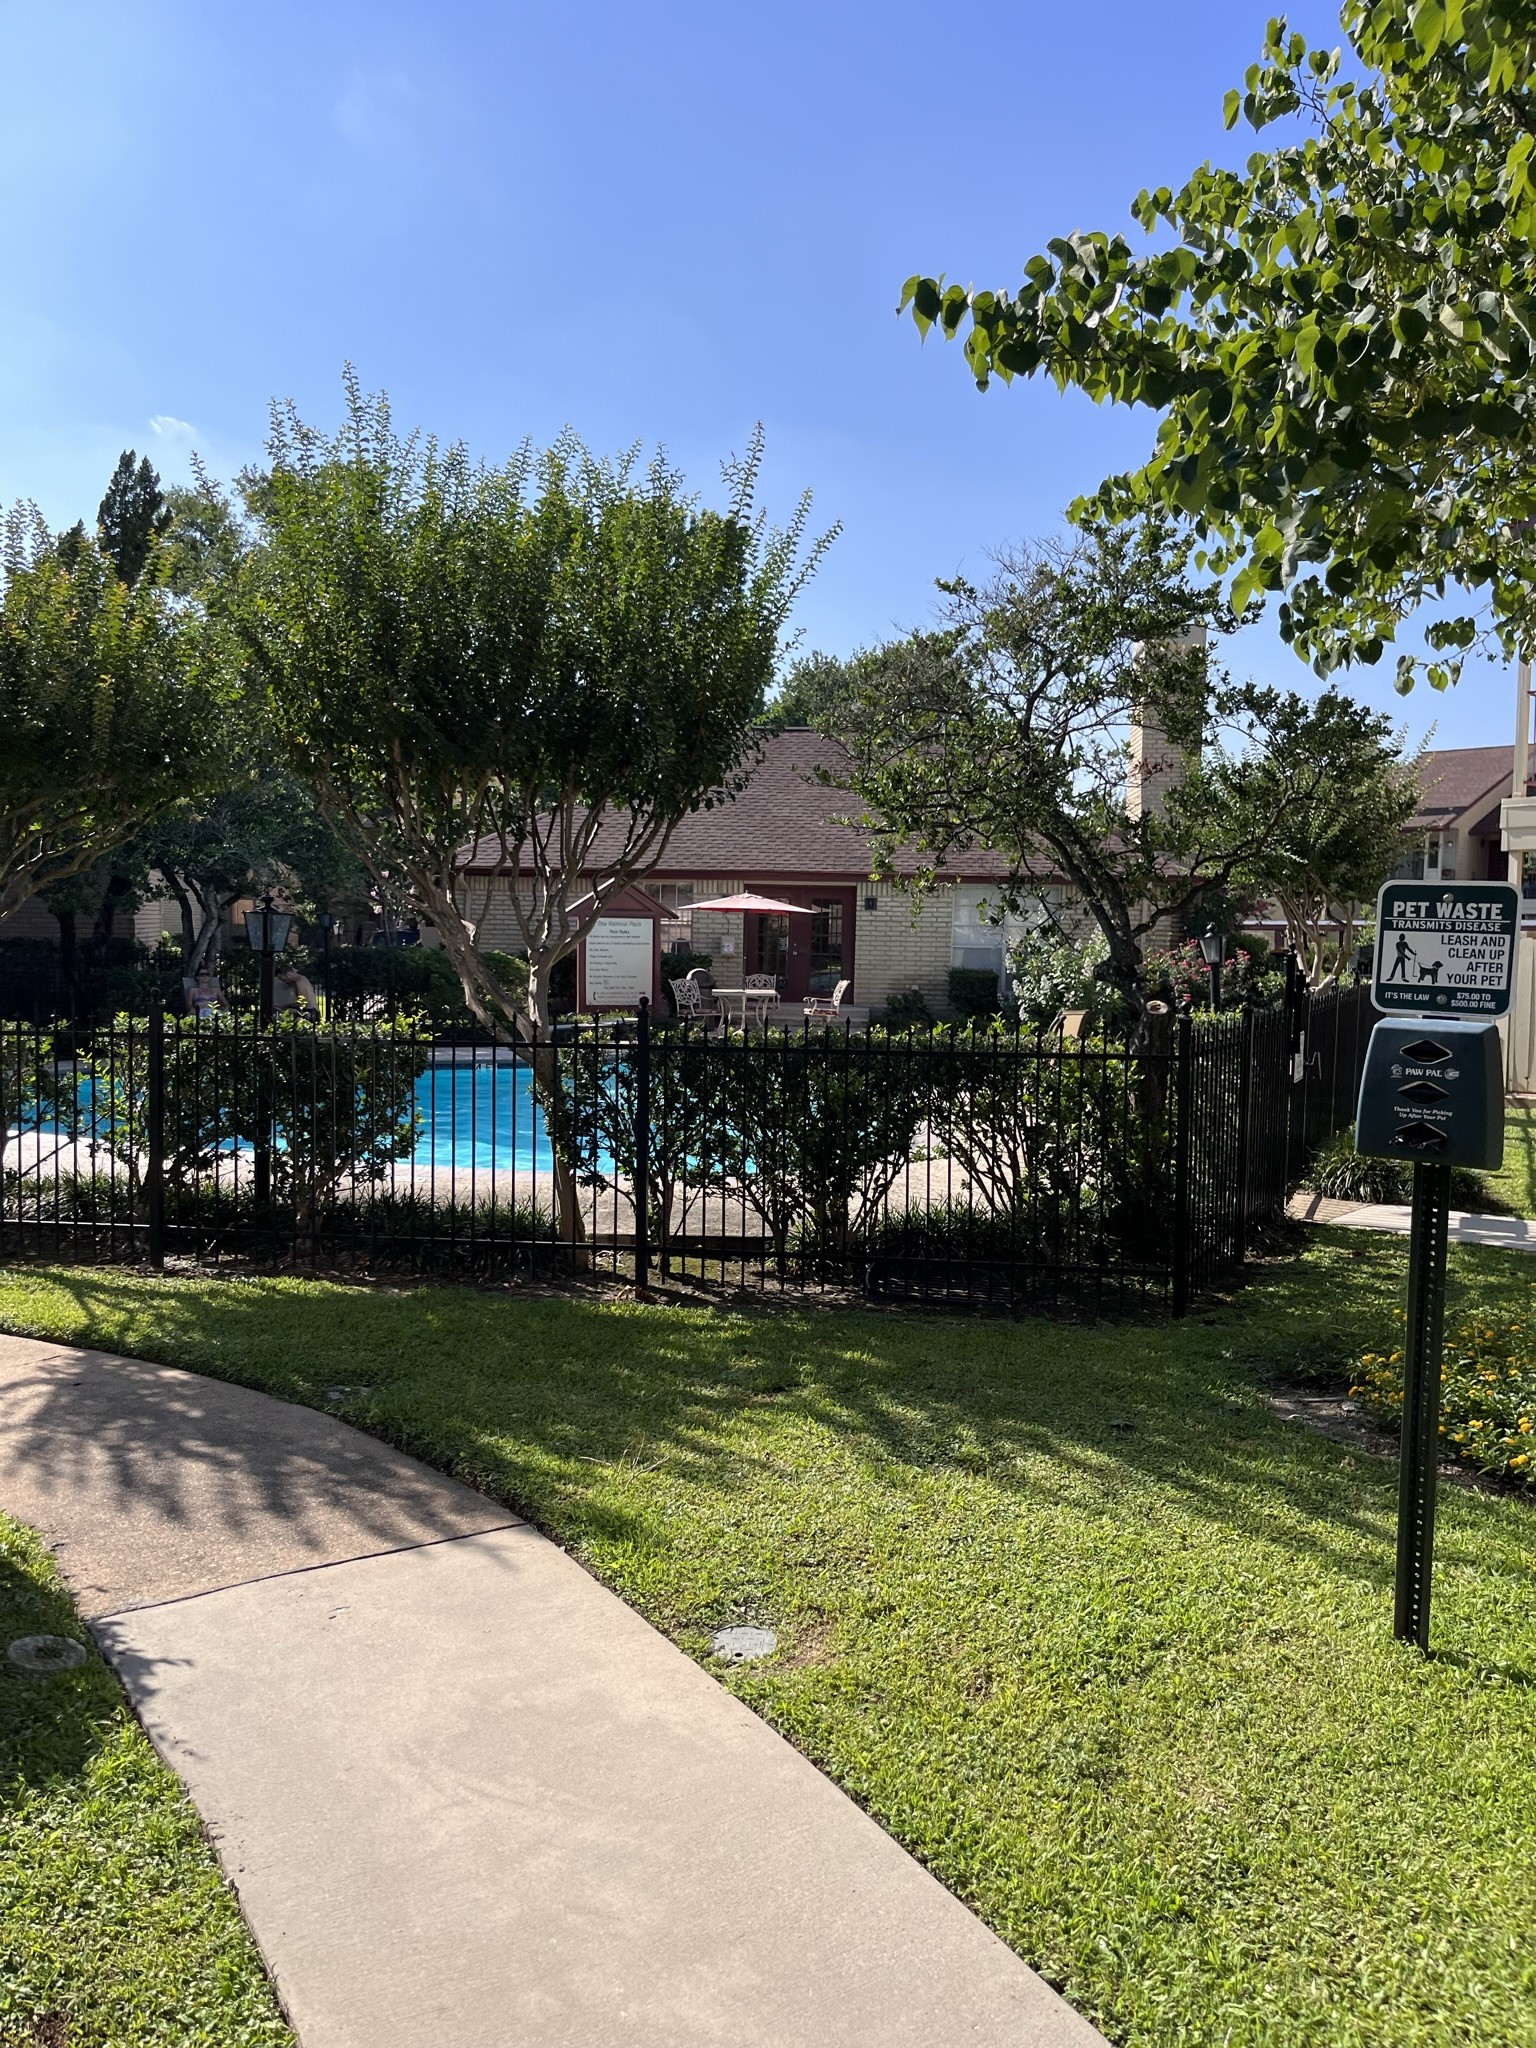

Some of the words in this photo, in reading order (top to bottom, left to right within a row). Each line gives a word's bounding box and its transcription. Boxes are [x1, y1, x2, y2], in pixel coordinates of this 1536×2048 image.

[1393, 901, 1430, 918] PET
[1436, 902, 1503, 919] WASTE
[1392, 920, 1452, 930] TRANSMITS
[1455, 921, 1501, 932] DISEASE
[1441, 935, 1477, 946] LEASH
[1480, 936, 1506, 947] AND
[1448, 948, 1486, 960] CLEAN
[1489, 949, 1505, 960] UP
[1466, 962, 1503, 973] AFTER
[1446, 973, 1477, 985] YOUR
[1481, 975, 1503, 986] PET
[1399, 992, 1412, 1000] THE
[1413, 993, 1430, 1001] LAW
[1456, 992, 1480, 1000] $75.00
[1482, 993, 1491, 1001] TO
[1451, 1000, 1478, 1008] $500.00
[1479, 1001, 1496, 1009] FINE
[1426, 1069, 1443, 1077] PAL
